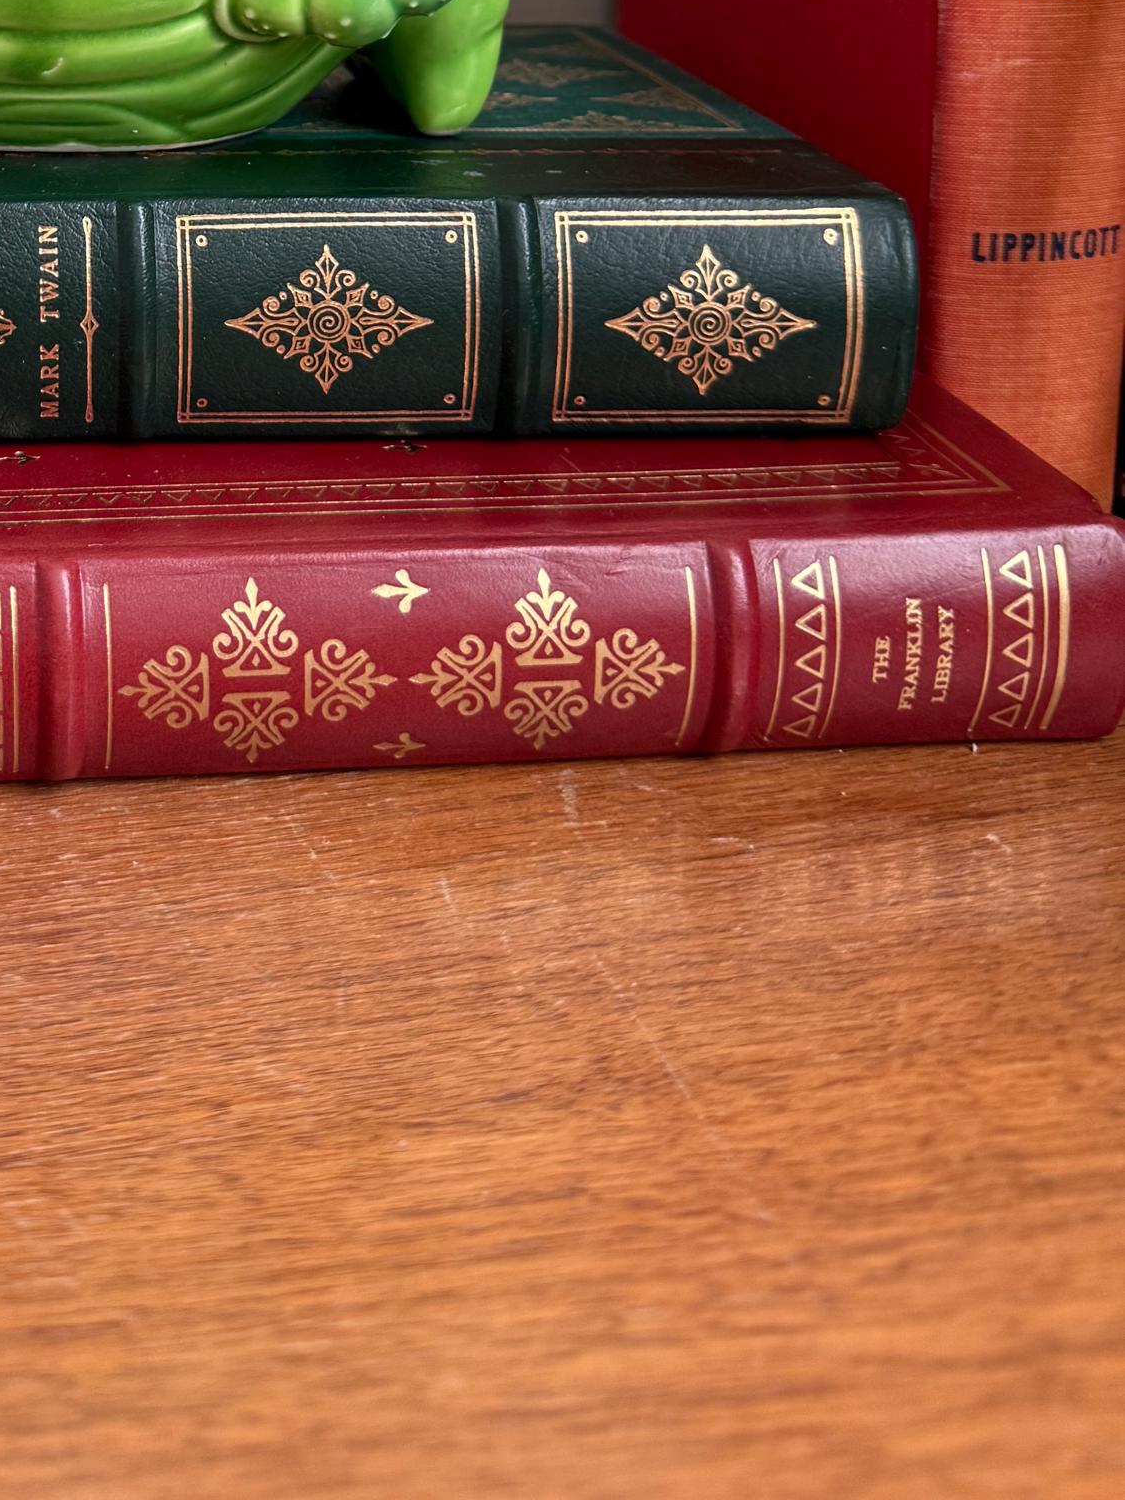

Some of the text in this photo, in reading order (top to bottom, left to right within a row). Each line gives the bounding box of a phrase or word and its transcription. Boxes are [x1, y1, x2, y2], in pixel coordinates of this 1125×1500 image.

[971, 225, 1121, 263] LIPPINCOTT
[38, 224, 61, 419] MARK TWAIN
[872, 635, 891, 684] THE
[896, 597, 924, 712] FRANKLIN
[930, 604, 956, 704] LIBRARY
